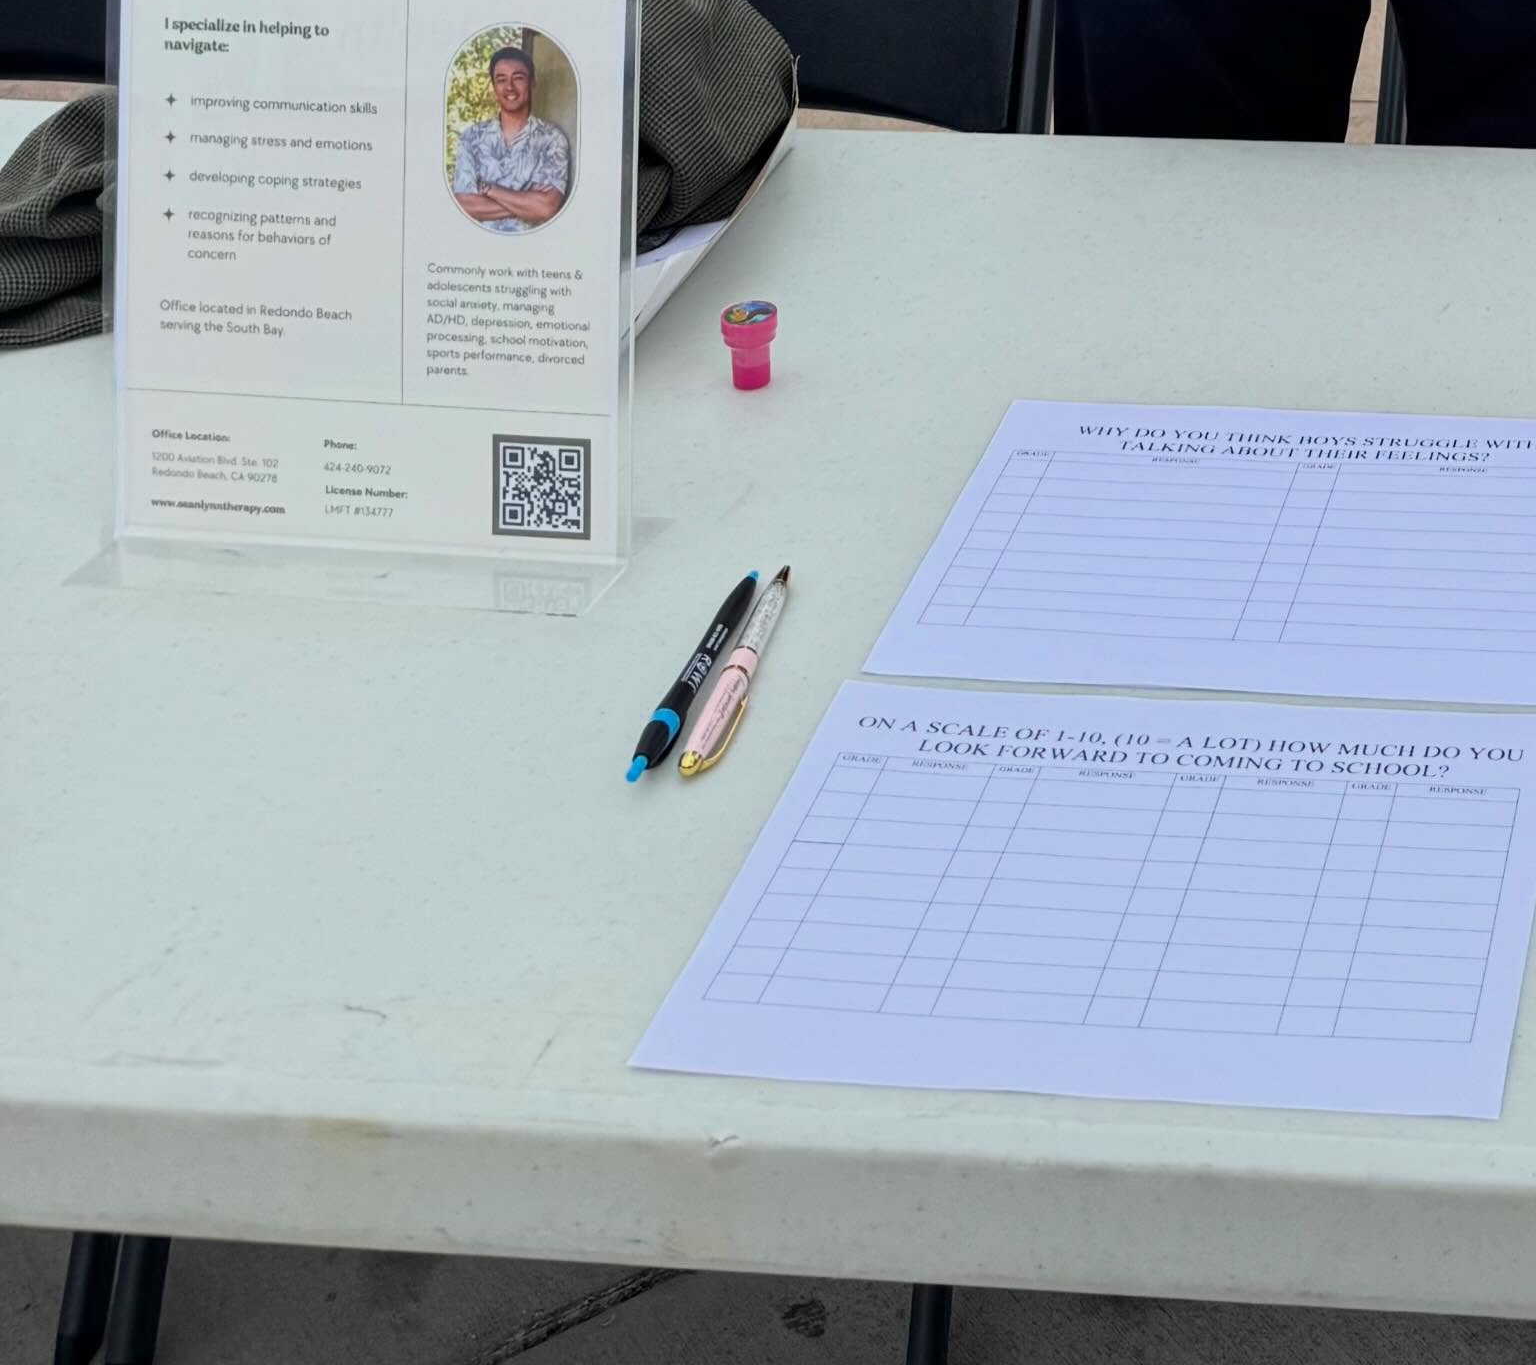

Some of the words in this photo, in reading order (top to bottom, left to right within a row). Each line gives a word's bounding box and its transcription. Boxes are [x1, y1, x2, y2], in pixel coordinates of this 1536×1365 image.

[171, 18, 240, 35] specialize
[244, 20, 256, 34] in
[260, 21, 310, 39] helping
[314, 24, 329, 36] to
[164, 38, 229, 53] navigate:
[190, 95, 249, 111] improving
[253, 97, 346, 114] communication
[350, 100, 377, 114] skills
[189, 133, 247, 150] managing
[251, 136, 286, 149] stress
[290, 136, 312, 149] and
[315, 137, 372, 151] emotions
[189, 171, 254, 188] developing
[258, 173, 298, 189] coping
[302, 174, 361, 191] strategies
[188, 210, 257, 227] recognizing
[260, 212, 311, 227] patterns
[314, 213, 336, 226] and
[188, 230, 234, 242] reasons
[238, 229, 254, 242] for
[258, 231, 314, 245] behaviors
[319, 233, 331, 245] of
[188, 248, 236, 261] concern
[428, 263, 486, 277] Commonly
[489, 267, 513, 277] work
[517, 268, 538, 278] with
[542, 270, 571, 279] teens
[428, 282, 491, 292] adolescents
[495, 285, 546, 297] struggling
[550, 286, 571, 297] with
[160, 300, 195, 312] Office
[200, 301, 243, 315] located
[247, 305, 256, 315] in
[261, 305, 313, 318] Redondo
[316, 308, 352, 320] Beach
[428, 298, 457, 308] social
[503, 303, 555, 315] managing
[160, 321, 201, 334] serving
[204, 321, 223, 332] the
[227, 322, 260, 334] South
[472, 317, 532, 329] depression,
[536, 322, 590, 331] emotional
[491, 335, 525, 345] school
[427, 350, 460, 359] sports
[538, 353, 585, 365] divorced
[1080, 425, 1128, 437] WHY
[1134, 429, 1166, 437] DO
[1174, 429, 1218, 439] YOU
[1228, 433, 1290, 445] THINK
[1300, 435, 1356, 445] BOYS
[1362, 437, 1478, 449] STRUGGLE
[1122, 441, 1216, 453] TALKING
[1222, 443, 1294, 457] ABOUT
[1308, 449, 1366, 459] THEIR
[1376, 451, 1490, 461] FEELINGS?
[324, 463, 391, 475] 424-240-9072
[151, 498, 285, 515] www.seanlynntherapy.com
[858, 717, 896, 729] ON
[926, 721, 1008, 739] SCALE
[1016, 729, 1048, 741] OF
[1202, 737, 1262, 751] LOT)
[1268, 739, 1332, 753] HOW
[1338, 743, 1414, 757] MUCH
[1424, 745, 1460, 757] DO
[1470, 747, 1524, 761] YOU
[918, 739, 990, 755] LOOK
[996, 743, 1128, 763] FORWARD
[1136, 751, 1170, 765] TO
[1176, 755, 1282, 771] COMING
[1292, 759, 1324, 771] TO
[1332, 761, 1450, 777] SCHOOL?
